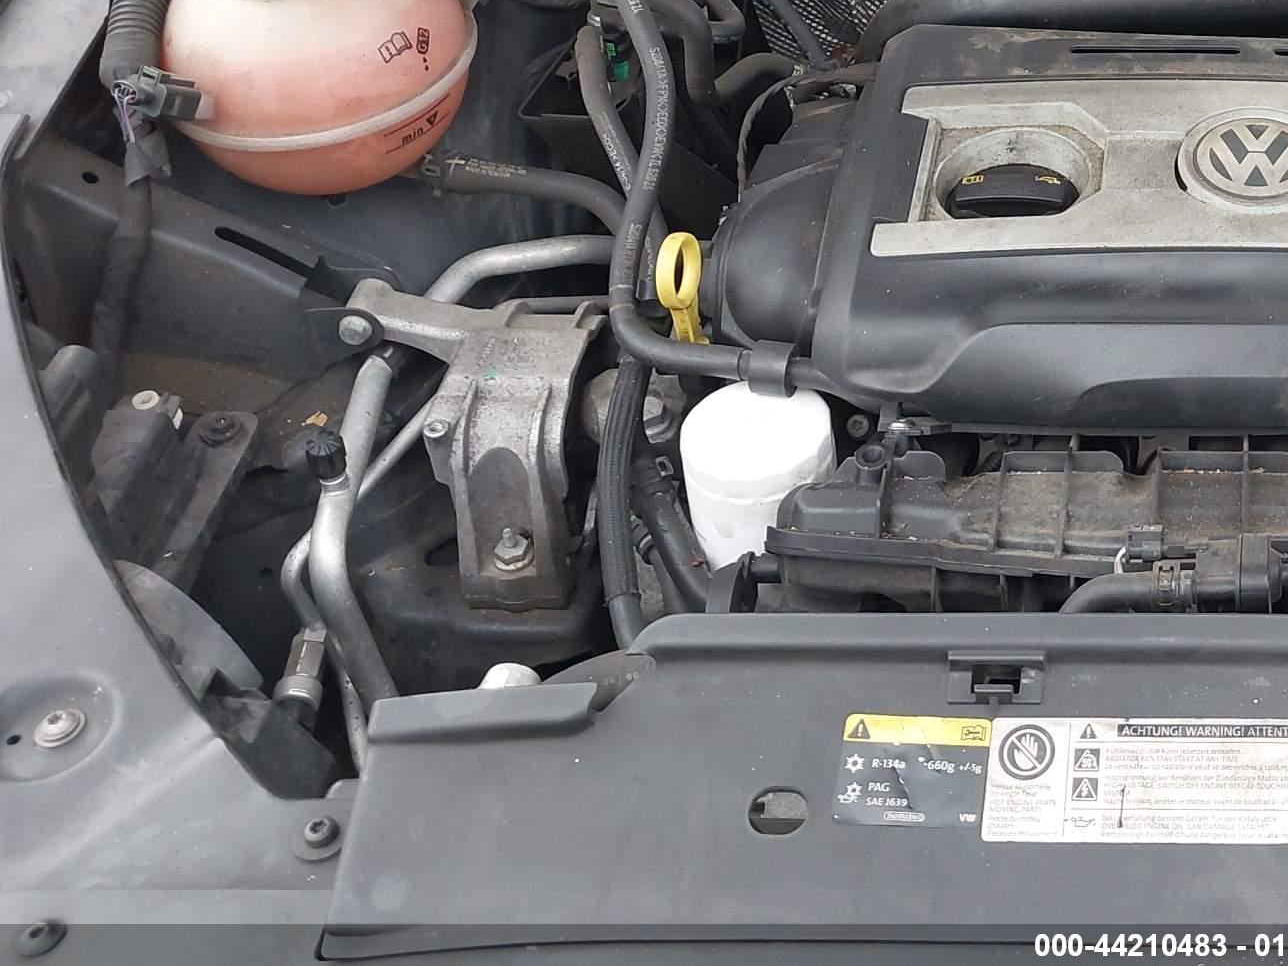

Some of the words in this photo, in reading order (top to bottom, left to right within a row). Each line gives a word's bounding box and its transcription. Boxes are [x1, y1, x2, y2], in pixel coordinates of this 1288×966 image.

[402, 127, 424, 145] min
[1122, 725, 1182, 736] ACHTUNG!
[1185, 727, 1244, 737] WARNING!
[871, 758, 907, 769] R-134a
[867, 782, 891, 792] PAG
[865, 797, 883, 806] SAE
[884, 797, 908, 807] J639
[959, 813, 977, 822] VW
